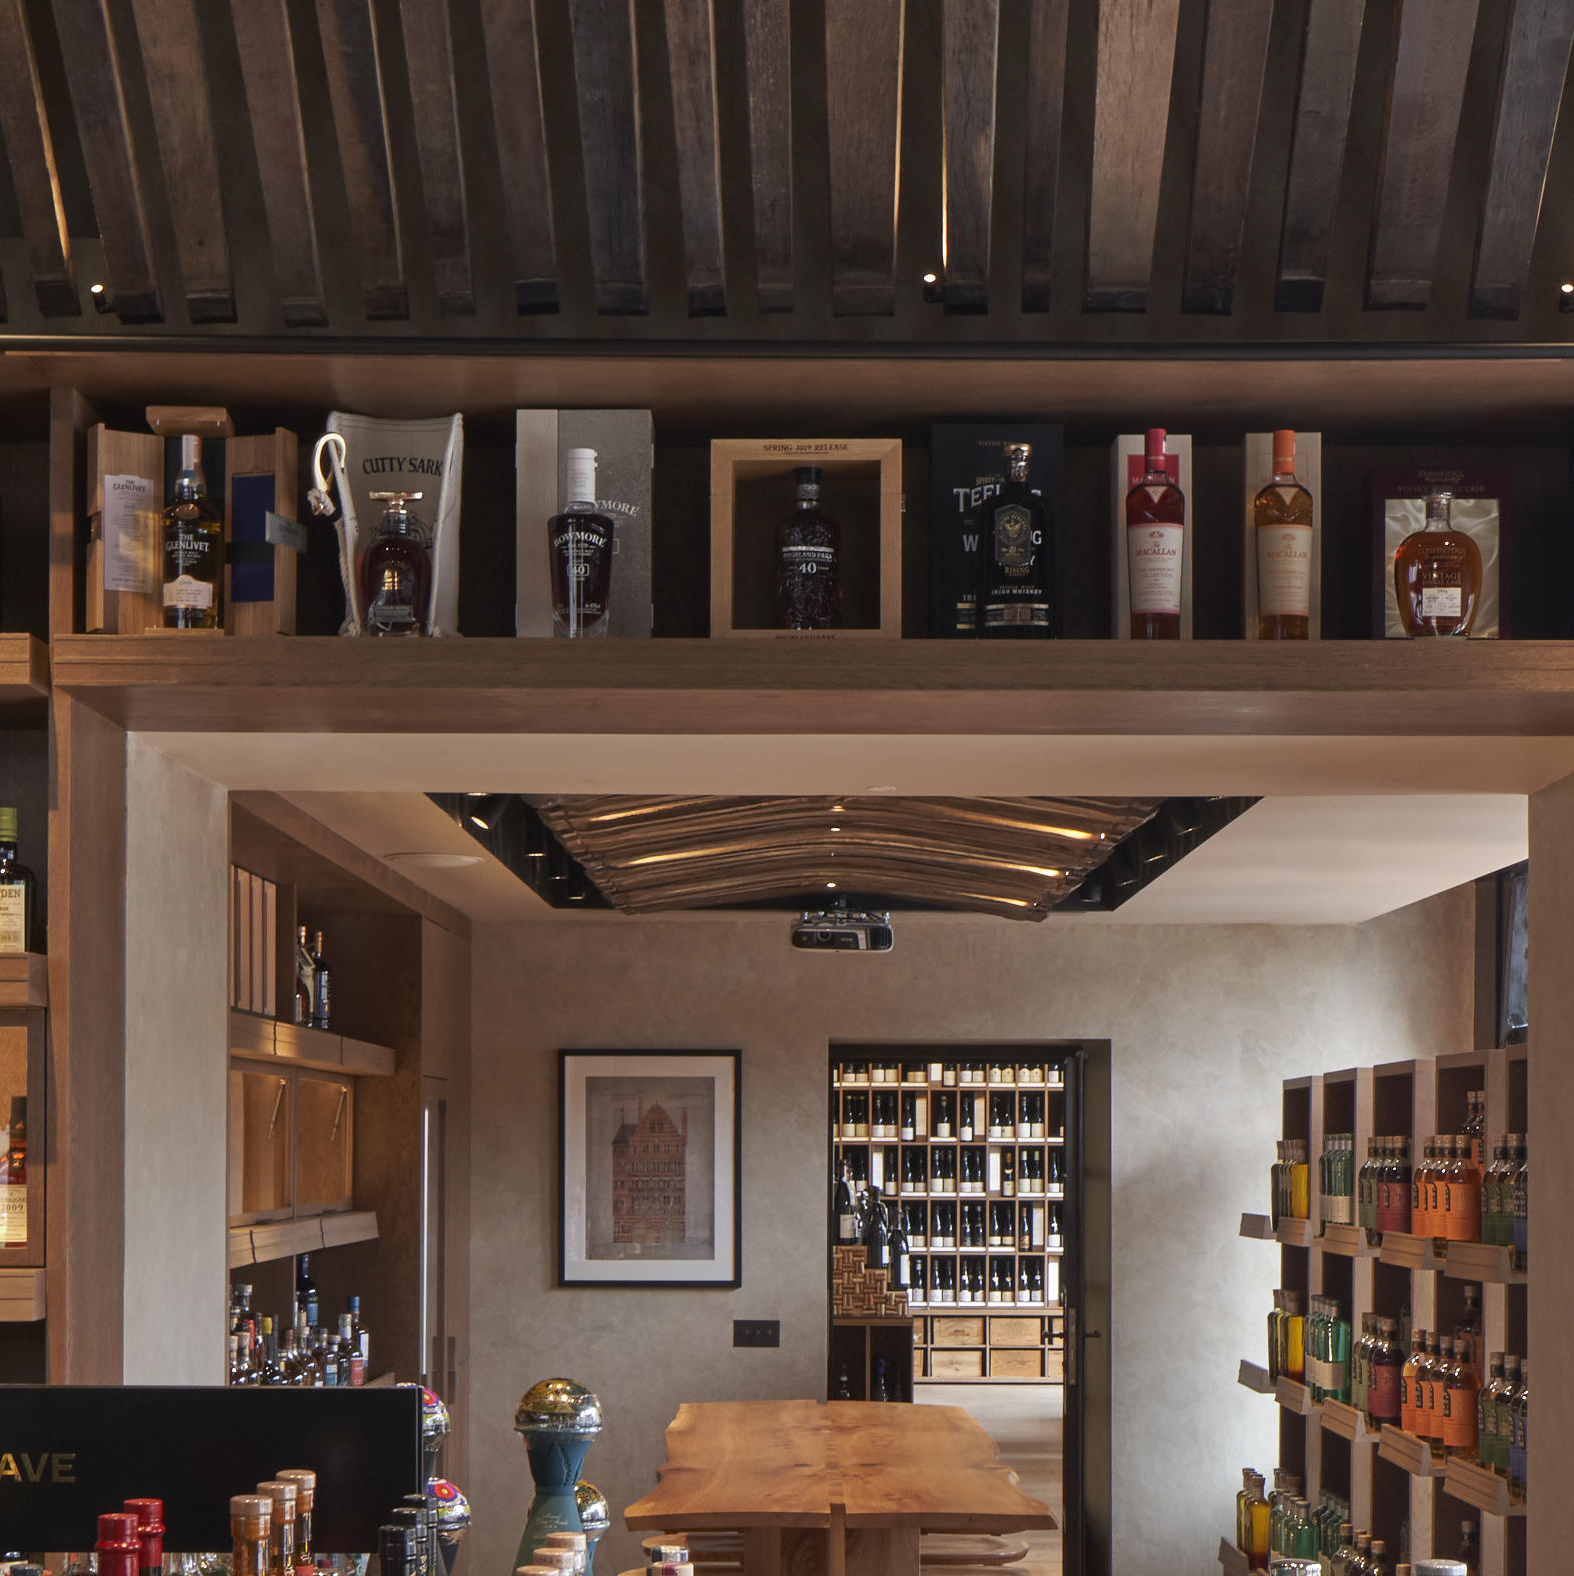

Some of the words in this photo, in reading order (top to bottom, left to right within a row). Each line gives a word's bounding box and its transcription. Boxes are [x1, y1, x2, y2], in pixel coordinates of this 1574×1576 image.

[763, 444, 792, 452] SPRING
[814, 443, 848, 451] RELEASE
[363, 458, 404, 475] CUTTY
[407, 458, 442, 476] SARK
[113, 484, 146, 493] GLENLIVET
[553, 530, 609, 548] BOWMORE
[165, 541, 210, 552] GLENLIVET
[1136, 549, 1177, 557] MACALLAN
[1267, 551, 1307, 560] MACALLAN
[799, 563, 817, 574] 40
[0, 1203, 24, 1212] 2009
